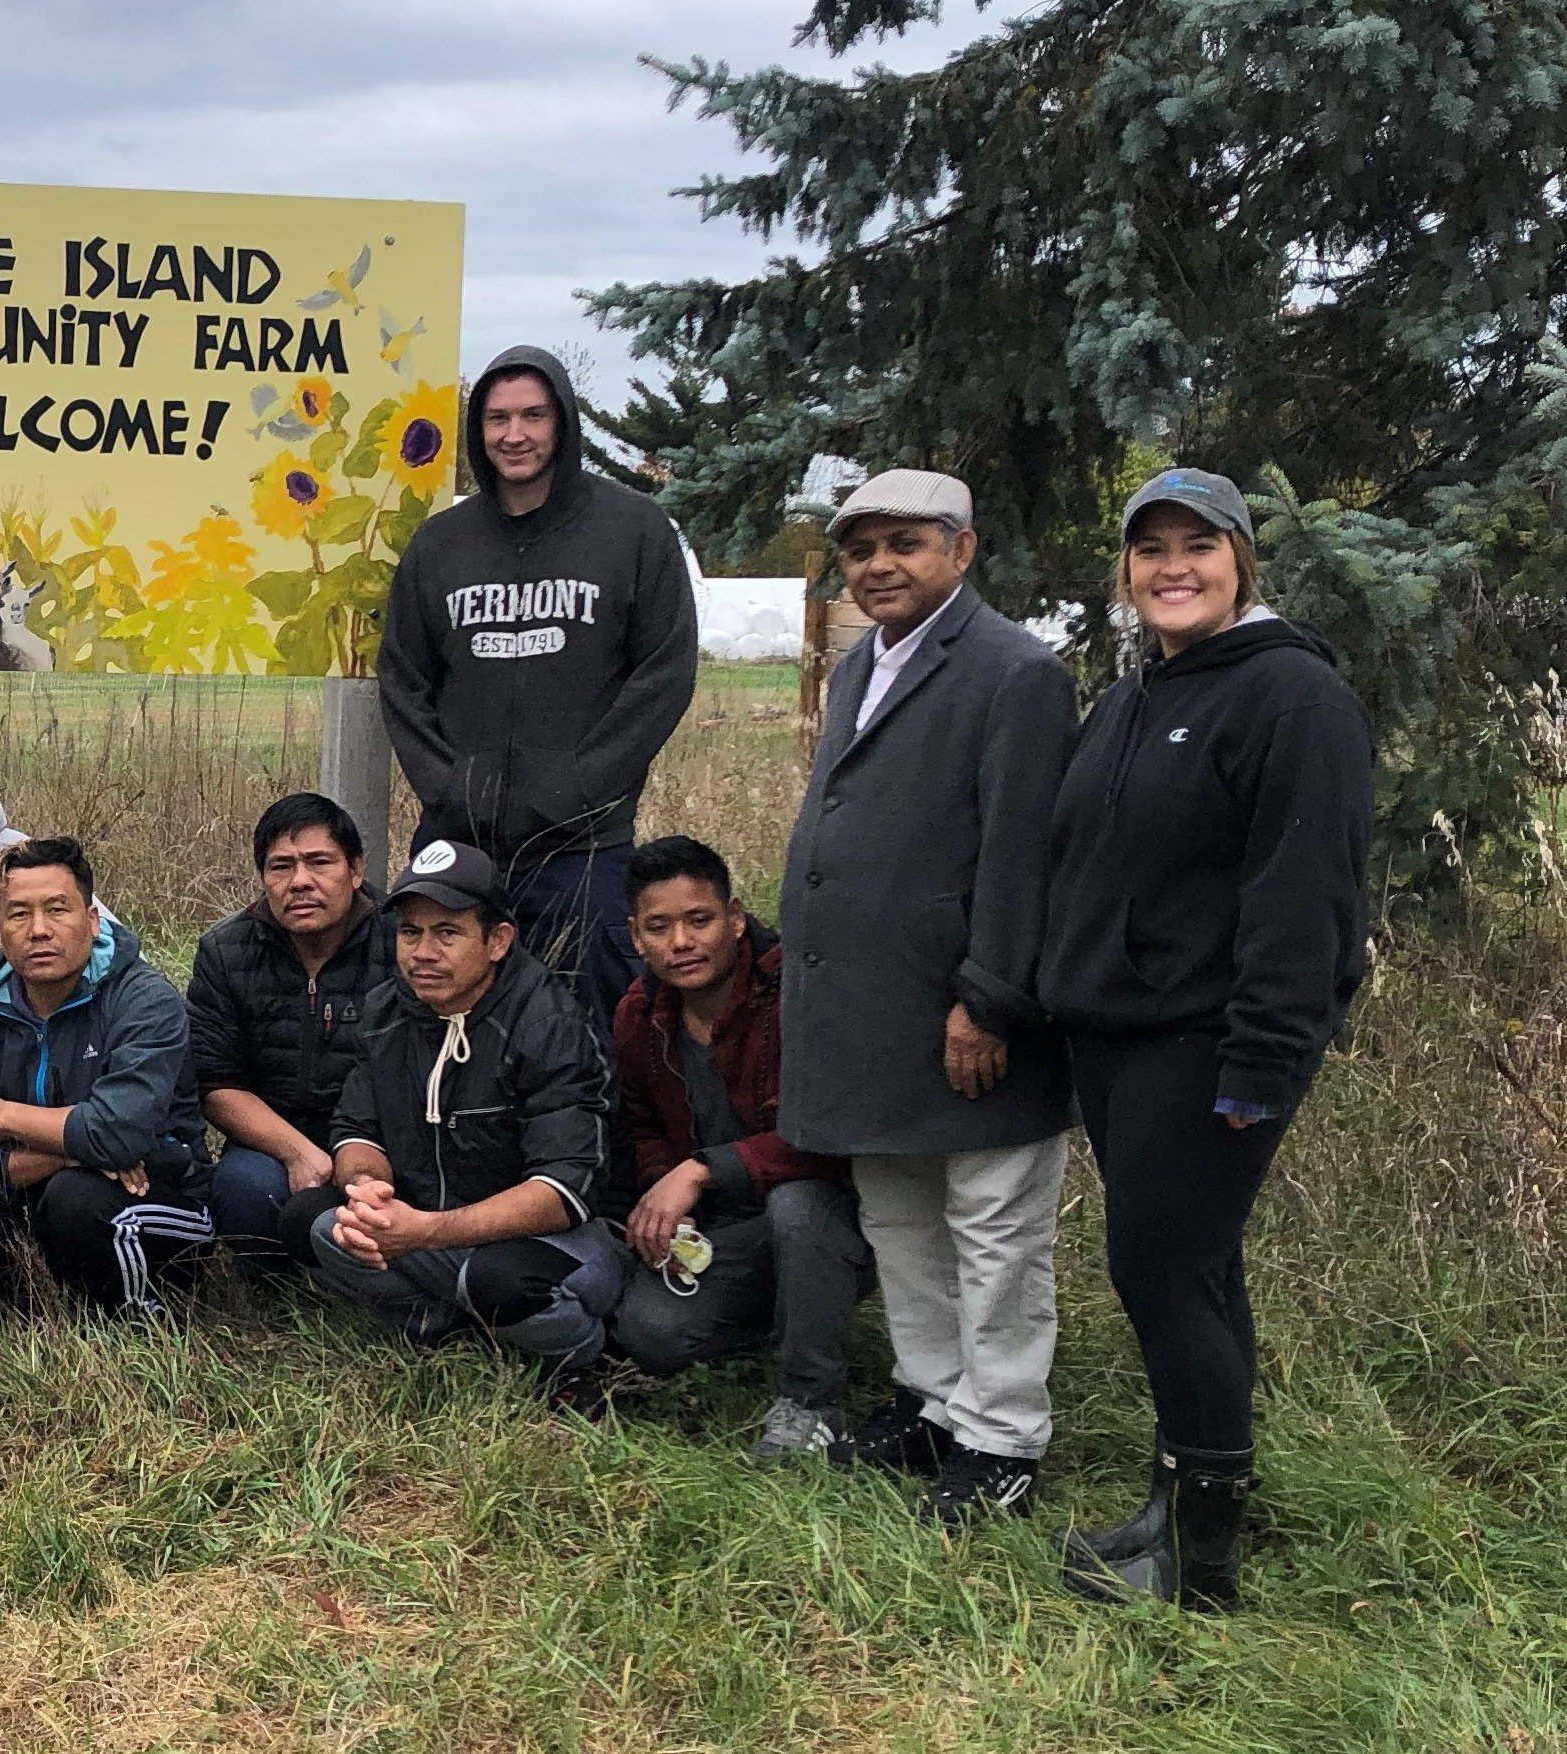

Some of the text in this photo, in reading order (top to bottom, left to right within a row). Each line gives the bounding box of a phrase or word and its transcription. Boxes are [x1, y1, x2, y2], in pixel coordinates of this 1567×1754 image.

[62, 236, 281, 303] ISLAND
[194, 314, 350, 374] FARM
[446, 579, 600, 631] VERMONT
[521, 632, 556, 653] 1791
